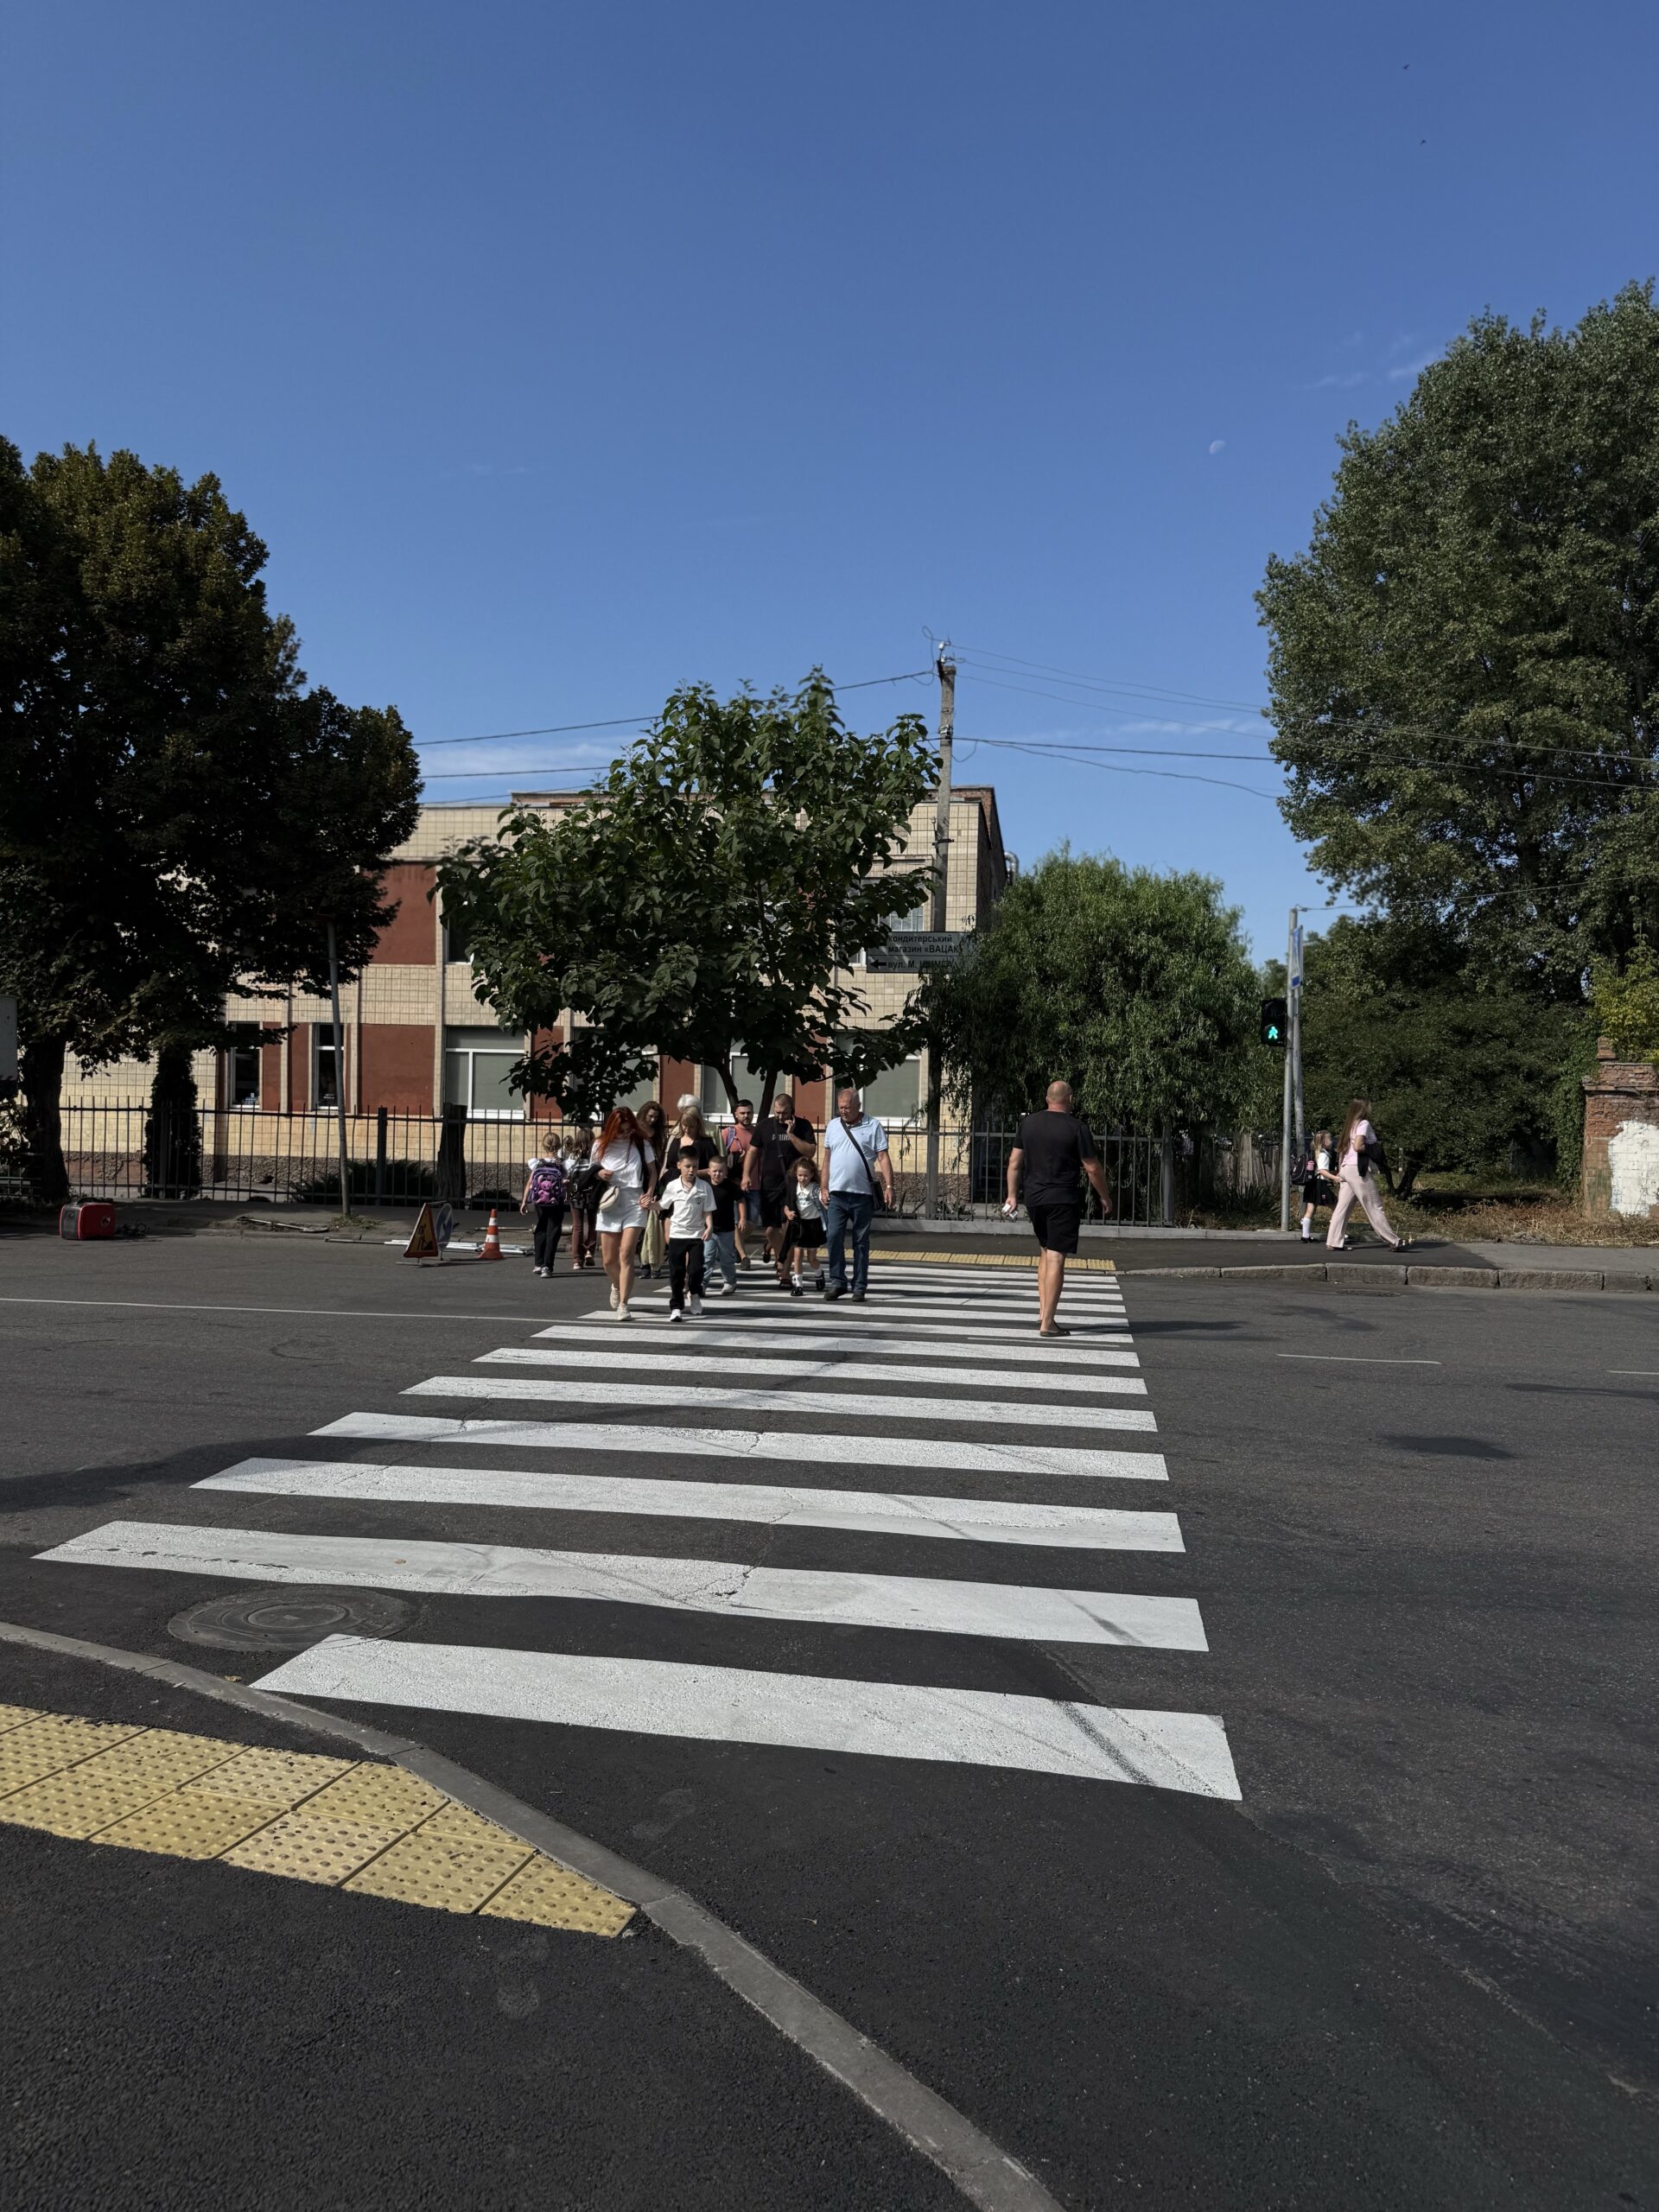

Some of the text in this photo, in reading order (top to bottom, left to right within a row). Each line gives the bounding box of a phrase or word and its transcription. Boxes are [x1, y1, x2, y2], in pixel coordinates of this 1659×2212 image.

[887, 934, 952, 944] кондитерський
[925, 944, 961, 954] «ВАЦАК
[887, 962, 906, 970] вул.
[908, 960, 918, 969] М.
